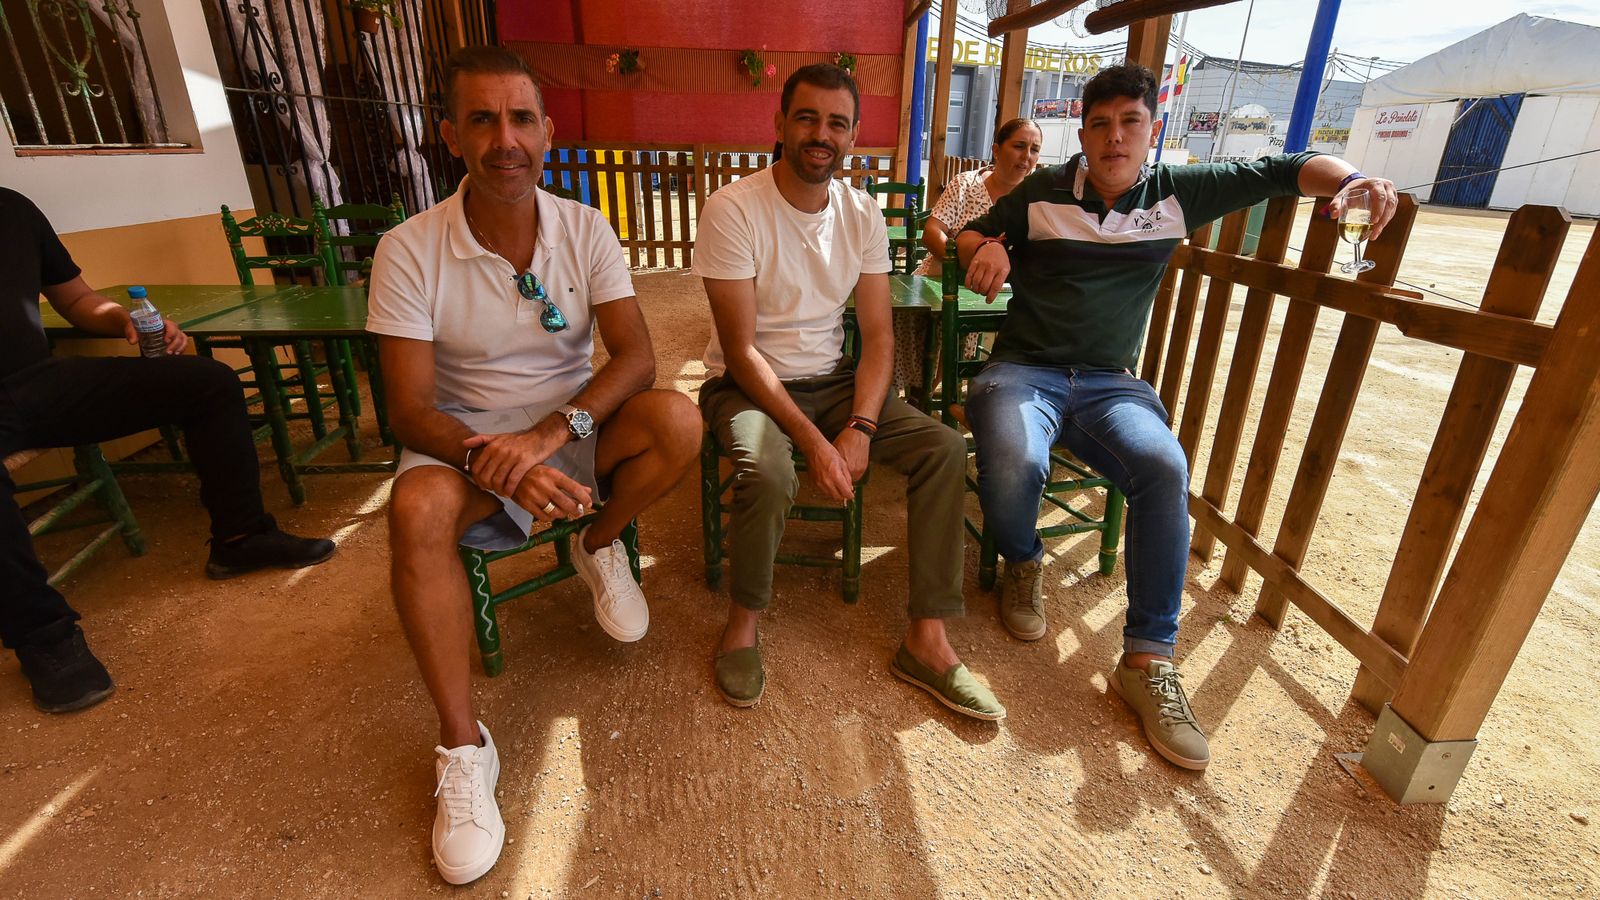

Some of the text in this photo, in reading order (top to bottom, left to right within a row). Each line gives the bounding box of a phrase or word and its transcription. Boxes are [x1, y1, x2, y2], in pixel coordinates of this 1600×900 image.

[951, 40, 980, 63] DE
[985, 41, 1101, 75] BMBEROS
[1376, 111, 1388, 124] La
